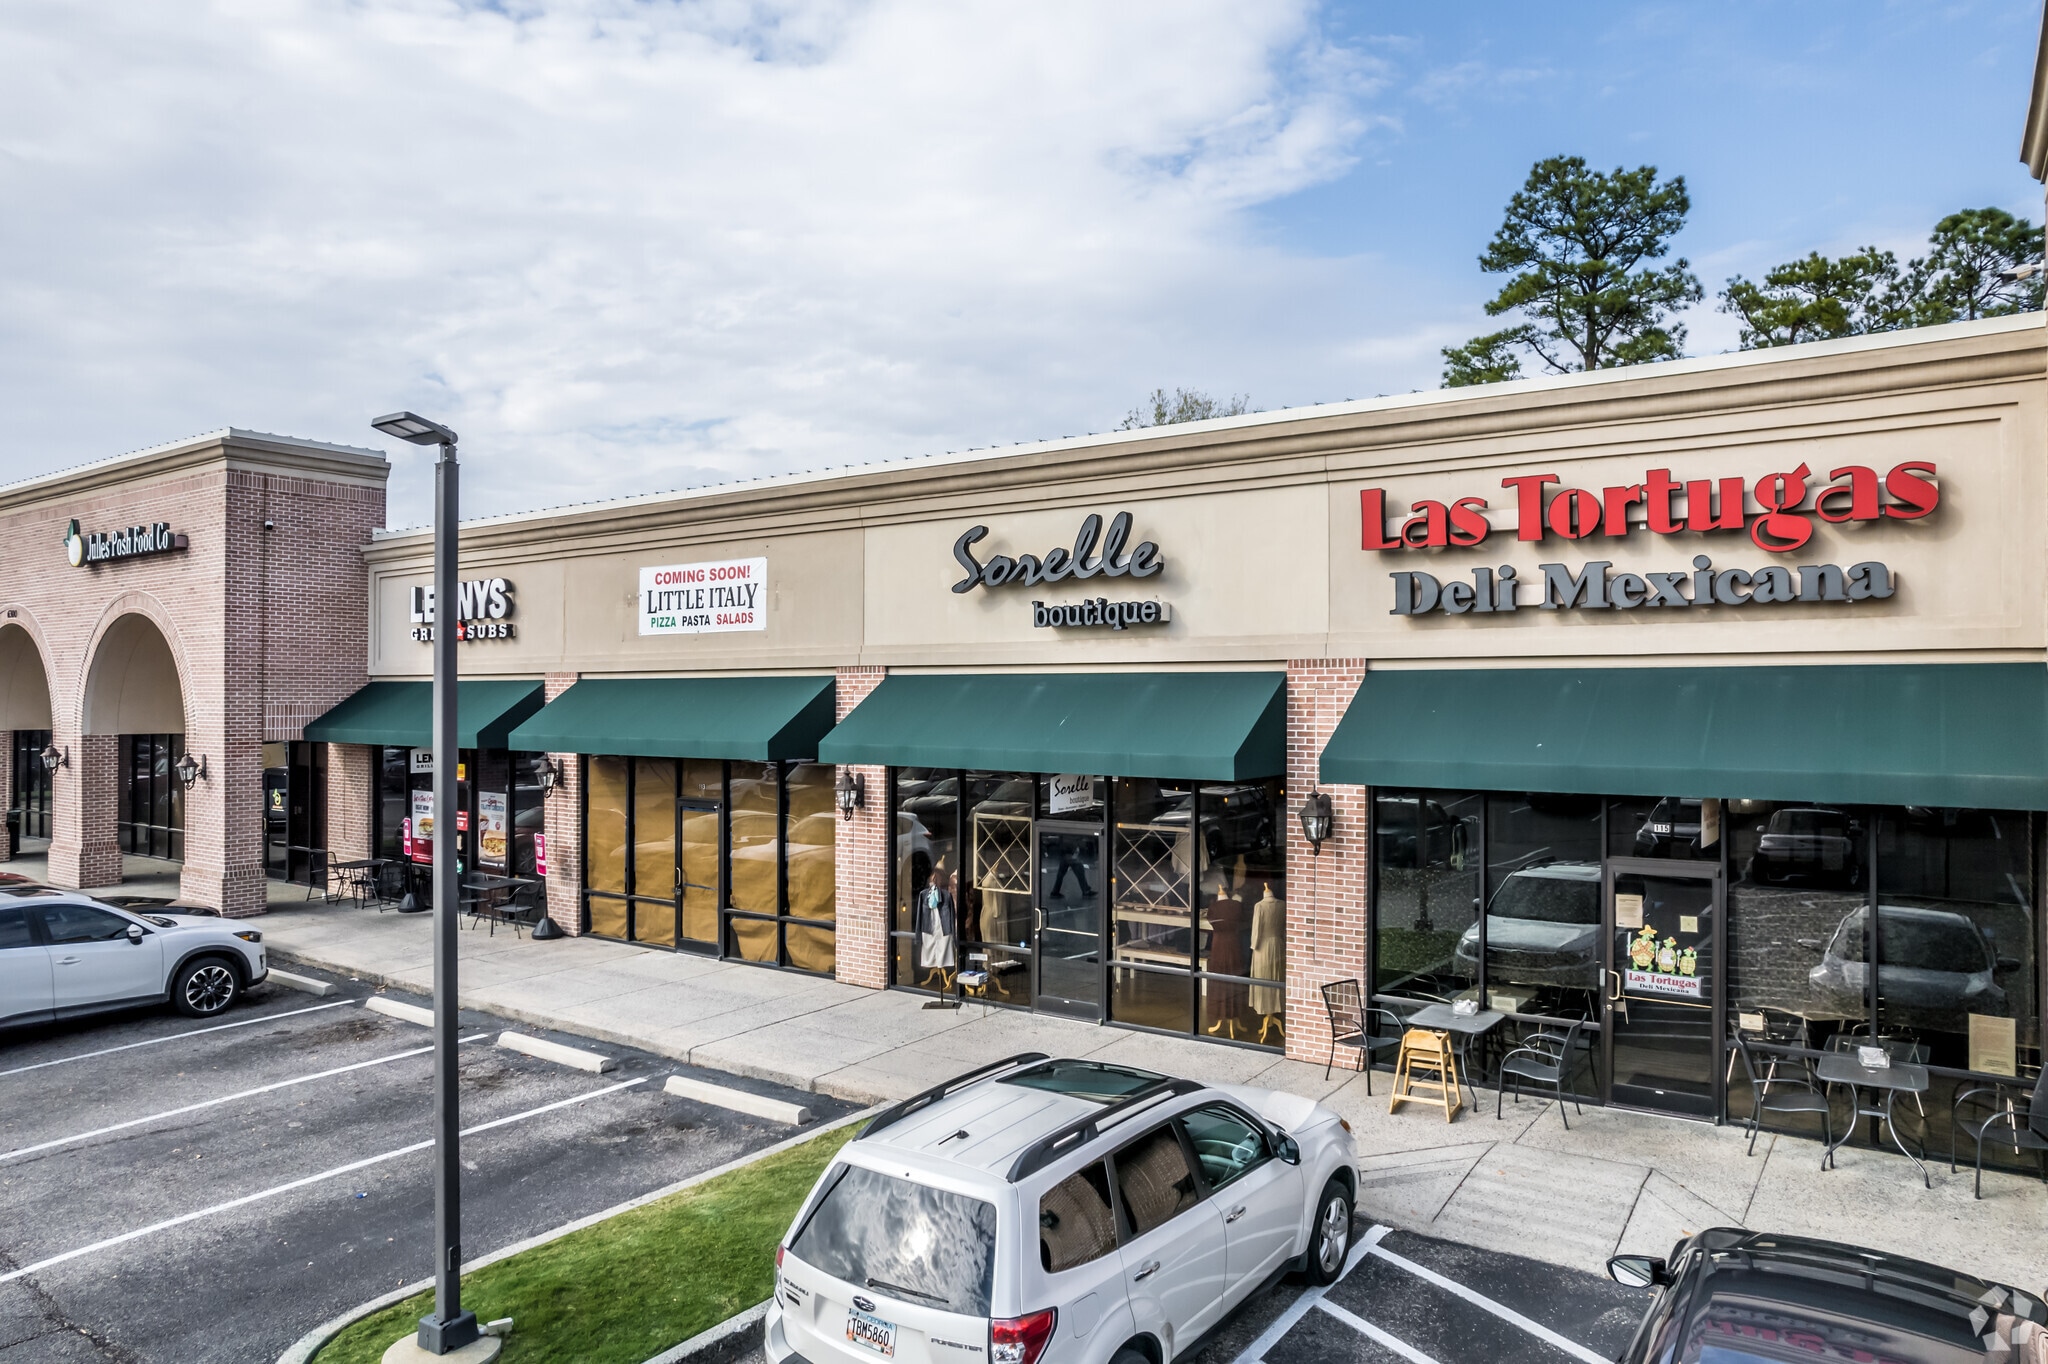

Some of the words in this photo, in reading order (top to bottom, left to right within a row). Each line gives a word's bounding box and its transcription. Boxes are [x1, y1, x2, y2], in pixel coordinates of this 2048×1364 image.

[1360, 487, 1489, 551] Las
[1501, 461, 1938, 553] Tortugas
[111, 527, 131, 556] Posh
[133, 522, 154, 553] Food
[156, 522, 169, 549] Co
[952, 511, 1164, 594] Sorelle
[655, 569, 705, 585] COMING
[709, 565, 751, 581] SOON!
[1389, 564, 1520, 616] Deli
[1538, 554, 1896, 610] Mexicana
[410, 578, 508, 623] LENYS
[647, 588, 704, 614] LITTLE
[709, 583, 759, 609] ITALY
[651, 616, 676, 628] PIZZA
[682, 615, 711, 627] PASTA
[716, 612, 753, 625] SALADS
[1032, 598, 1158, 630] boutique
[467, 623, 507, 639] SUBS
[1055, 775, 1089, 797] Sorelle
[1655, 824, 1669, 833] 115
[1628, 972, 1646, 982] Las
[1650, 975, 1697, 989] Tortugas
[1640, 983, 1654, 991] Deli
[1656, 985, 1690, 994] Mexicana
[851, 1317, 890, 1347] TBM5860
